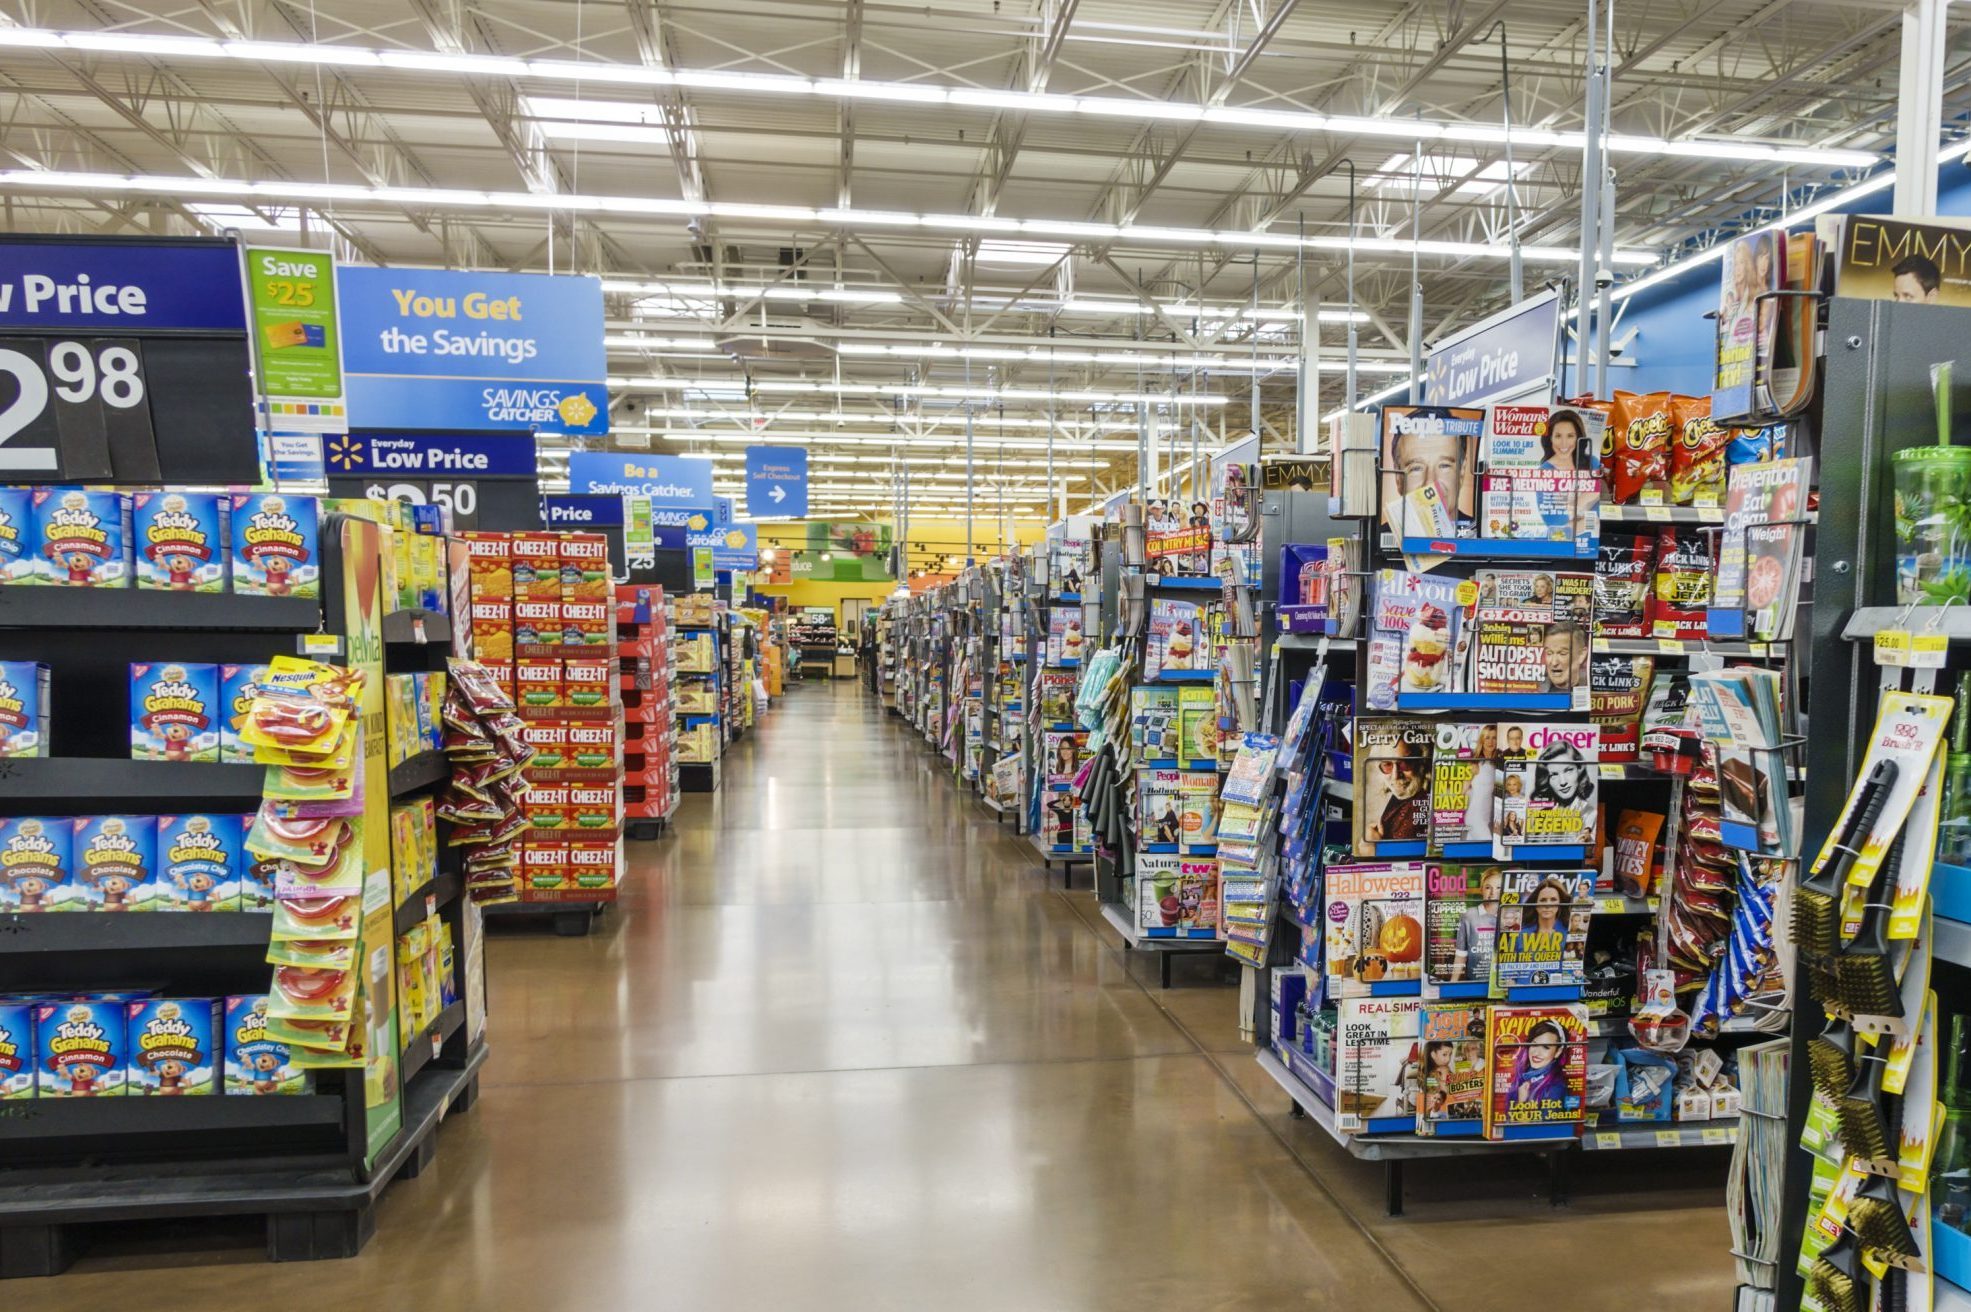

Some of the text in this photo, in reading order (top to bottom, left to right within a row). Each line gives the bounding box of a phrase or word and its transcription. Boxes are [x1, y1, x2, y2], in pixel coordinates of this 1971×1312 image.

[262, 257, 317, 278] Save
[24, 273, 147, 315] Price
[267, 281, 315, 307] $25
[392, 289, 523, 321] You Get
[381, 327, 538, 364] the Savings
[1452, 347, 1476, 368] Everyday
[1449, 347, 1519, 400] Low Price
[482, 387, 560, 409] SAVINGS
[488, 407, 558, 423] CATCHER
[1495, 407, 1549, 422] Woman's
[1389, 411, 1480, 439] People TRIBUTE
[1494, 421, 1533, 435] World
[371, 438, 415, 450] Everyday
[371, 448, 488, 469] Low Price
[624, 464, 658, 478] Be a
[753, 472, 801, 481] Self Checkout
[762, 464, 791, 473] Express
[1542, 470, 1553, 478] 30
[1553, 470, 1571, 478] DAYS
[1729, 466, 1799, 492] Prevention
[589, 481, 695, 498] Savings Catcher.
[1743, 492, 1766, 511] Eat
[52, 509, 100, 531] Teddy
[551, 505, 593, 521] Price
[1728, 511, 1769, 530] Clean
[153, 511, 200, 532] Teddy
[251, 511, 298, 532] Teddy
[46, 523, 107, 543] Grahams
[147, 525, 206, 545] Grahams
[244, 527, 304, 546] Grahams
[1752, 527, 1787, 543] Weight
[54, 541, 102, 553] Cinnamon
[155, 544, 202, 555] Cinnamon
[252, 545, 299, 557] Cinnamon
[513, 539, 558, 556] CHEEZ-IT
[560, 540, 605, 558] CHEEZ-IT
[1147, 536, 1184, 552] COUNTRY
[1556, 586, 1593, 595] MURDER?
[1580, 579, 1588, 587] IT
[1414, 583, 1456, 603] you
[516, 602, 560, 619] CHEEZ-IT
[562, 603, 606, 620] CHEEZ-IT
[1382, 599, 1416, 618] Save
[1479, 610, 1553, 622] GLOBE
[1479, 644, 1544, 663] AUTOPSY
[272, 671, 317, 684] Nesquik
[517, 665, 562, 682] CHEEZ-IT
[566, 666, 608, 682] CHEEZ-IT
[1479, 662, 1546, 681] SHOCKER!
[1611, 677, 1641, 687] LINK'S
[151, 681, 198, 703] Teddy
[145, 695, 204, 714] Grahams
[1608, 695, 1633, 709] PORK
[151, 713, 199, 725] Cinnamon
[523, 727, 567, 743] CHEEZ-IT
[570, 728, 614, 743] CHEEZ-IT
[1360, 730, 1401, 748] Jerry
[1529, 727, 1597, 749] closer
[1895, 723, 1919, 739] BBQ
[1609, 742, 1635, 752] LINK'S
[1664, 736, 1678, 745] CUPS
[1435, 766, 1473, 780] 10 LBS
[1434, 781, 1462, 795] IN 10
[525, 789, 568, 804] CHEEZ-IT
[571, 789, 614, 804] CHEEZ-IT
[1434, 795, 1469, 810] DAYS!
[1527, 809, 1560, 817] Farewell
[1561, 809, 1572, 817] to
[1526, 817, 1583, 833] LEGEND
[7, 834, 53, 854] Teddy
[91, 833, 137, 853] Teddy
[175, 832, 221, 852] Teddy
[1, 849, 60, 867] Grahams
[84, 848, 142, 866] Grahams
[168, 847, 227, 865] Grahams
[525, 850, 568, 865] CHEEZ-IT
[571, 850, 614, 865] CHEEZ-IT
[1142, 858, 1179, 868] Natura
[7, 866, 56, 877] Chocolate
[91, 866, 137, 876] Chocolate
[169, 862, 228, 876] Chocolatey Chip
[1326, 872, 1423, 896] Halloween
[1429, 867, 1467, 893] Good
[1503, 873, 1539, 893] Life
[1499, 932, 1519, 952] AT
[1523, 932, 1563, 952] WAR
[1519, 952, 1533, 962] THE
[1535, 952, 1562, 962] QUEEN
[1360, 1004, 1391, 1014] REAL
[58, 1021, 104, 1042] Teddy
[149, 1018, 196, 1039] Teddy
[1346, 1023, 1371, 1032] LOOK
[1346, 1030, 1388, 1039] GREAT IN
[50, 1035, 110, 1054] Grahams
[140, 1032, 198, 1050] Grahams
[237, 1043, 275, 1055] Chocolatey
[1345, 1038, 1390, 1047] LESS TIME
[58, 1053, 105, 1064] Cinnamon
[147, 1050, 193, 1061] Chocolate
[1451, 1079, 1484, 1093] BUSTERS
[1510, 1099, 1562, 1110] Look Hot
[1494, 1109, 1582, 1122] In YOUR Jeans!
